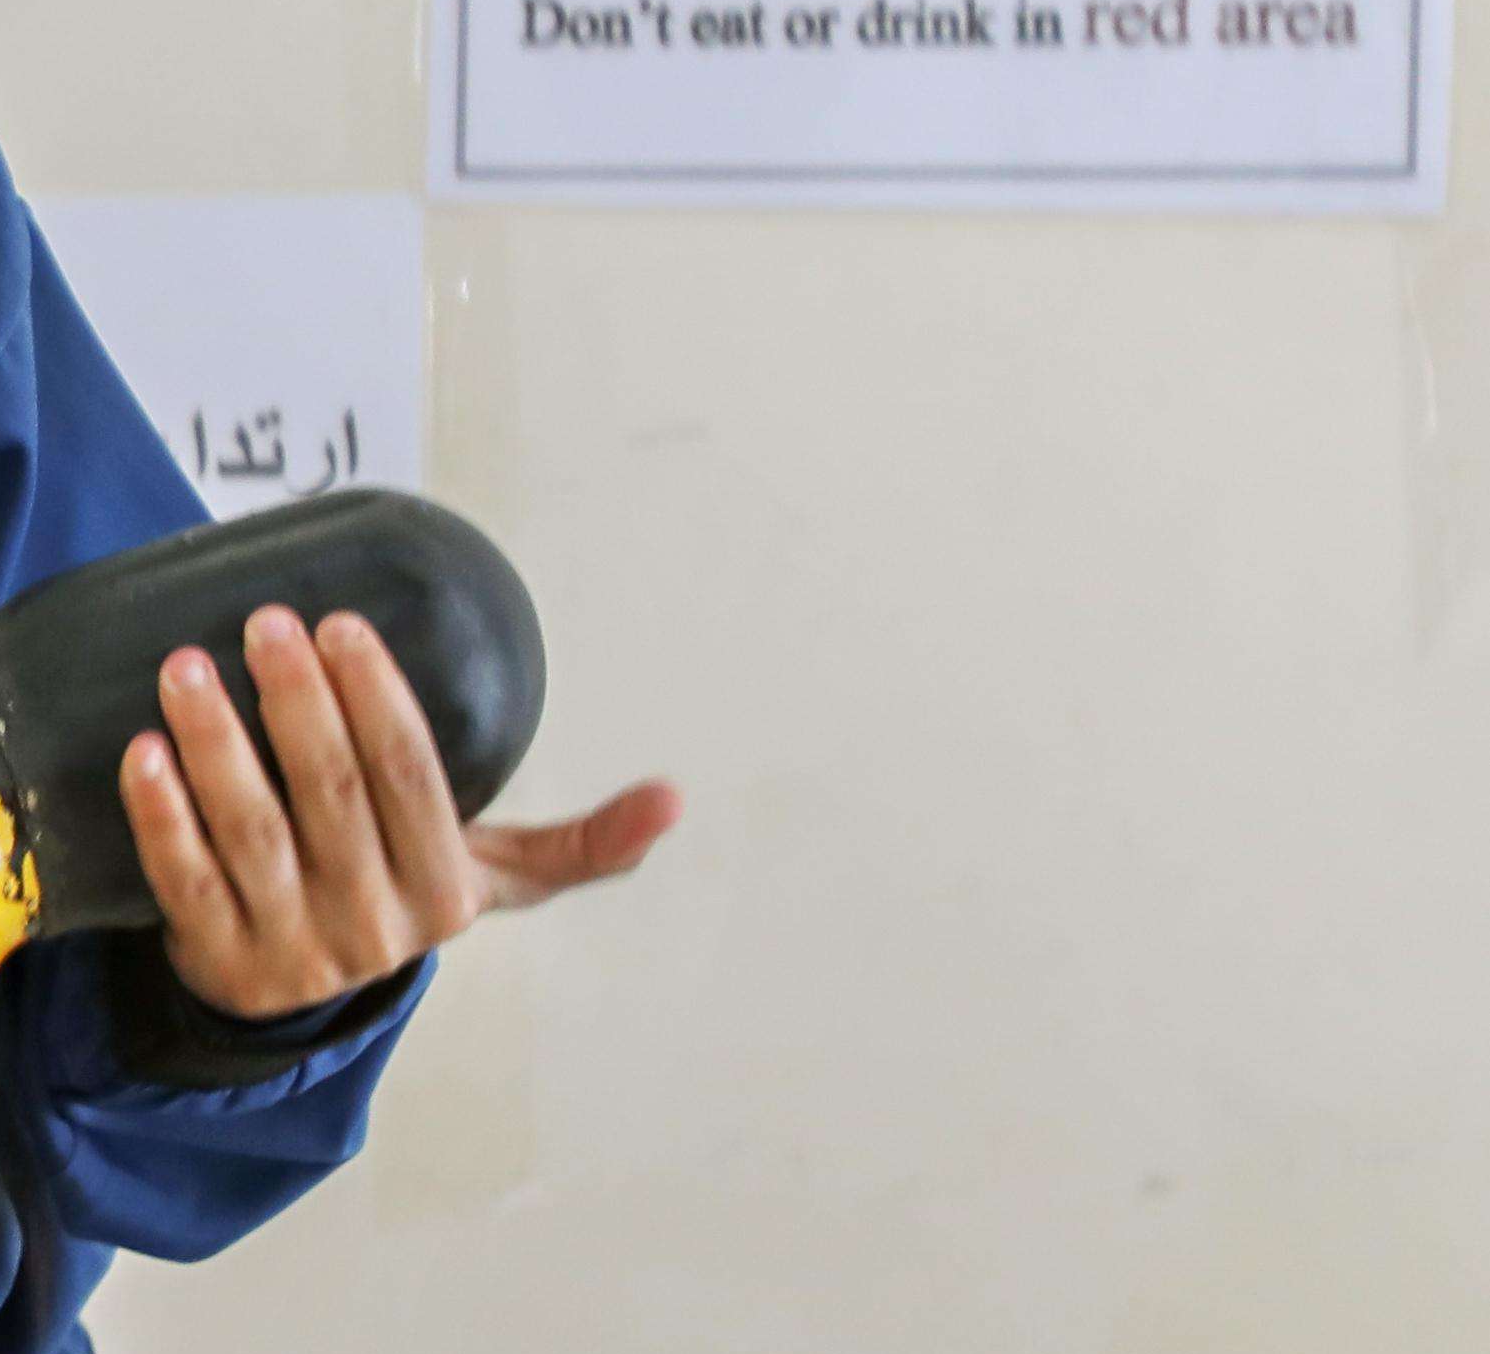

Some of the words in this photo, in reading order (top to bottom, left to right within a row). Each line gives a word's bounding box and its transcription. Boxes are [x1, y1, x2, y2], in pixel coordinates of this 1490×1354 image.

[687, 0, 765, 49] eat
[781, 6, 840, 49] or
[1215, 0, 1357, 46] area
